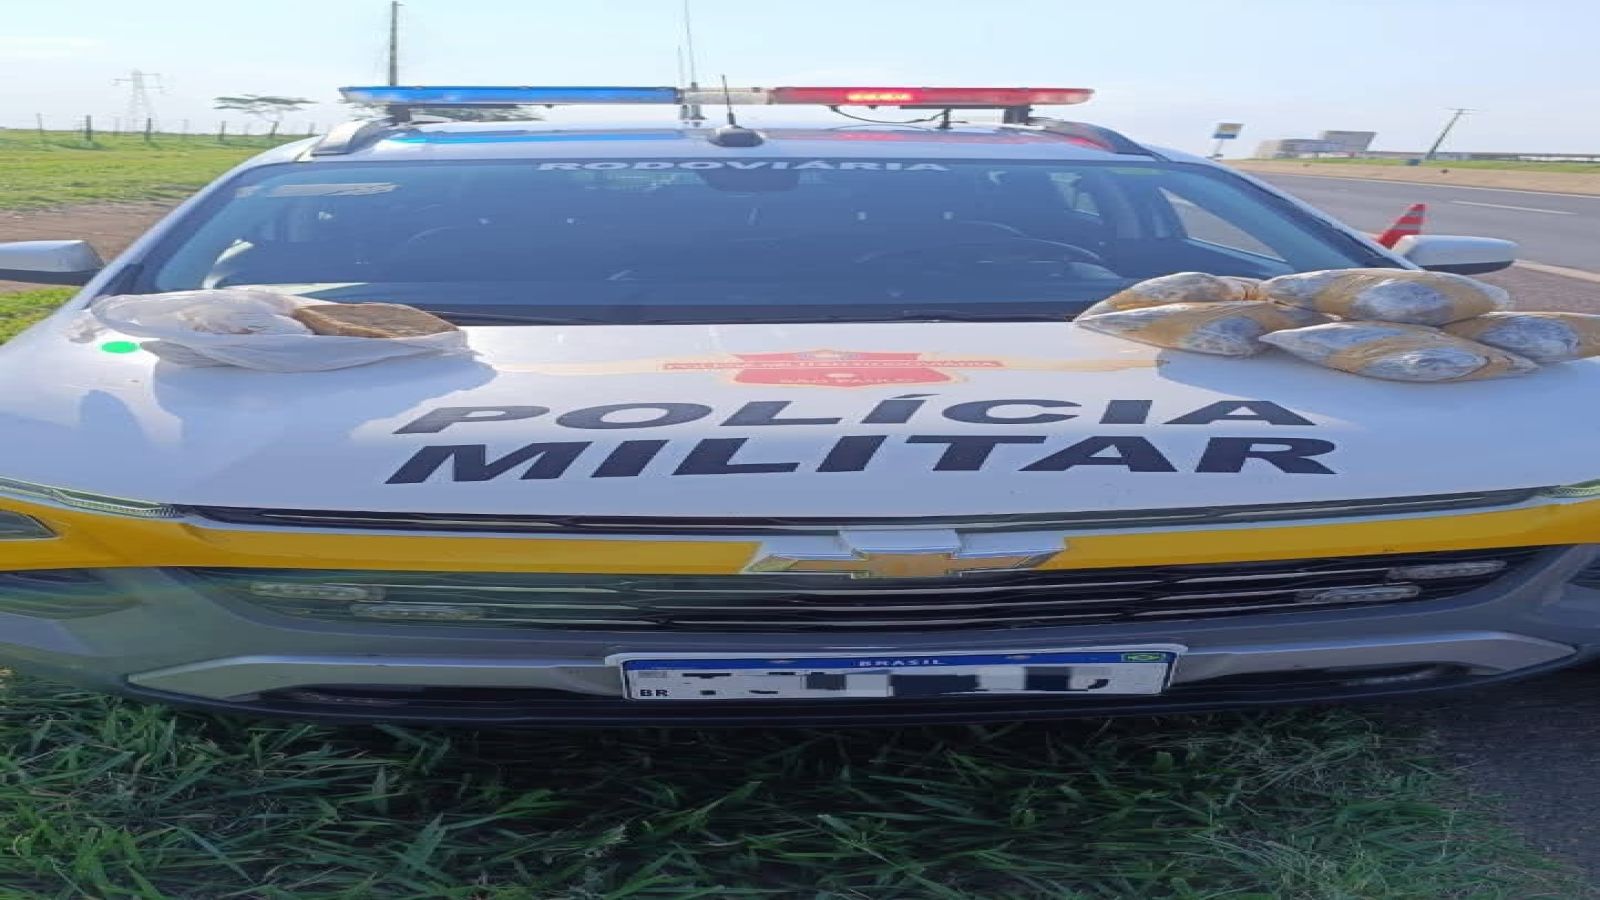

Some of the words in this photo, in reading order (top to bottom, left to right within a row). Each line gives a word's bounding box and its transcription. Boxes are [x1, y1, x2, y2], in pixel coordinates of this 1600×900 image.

[537, 161, 949, 171] RODOVIÁRIA
[393, 394, 1317, 434] POLÍCIA
[385, 434, 1338, 485] MILITAR
[859, 659, 946, 667] BRASIL
[639, 689, 670, 697] BR
